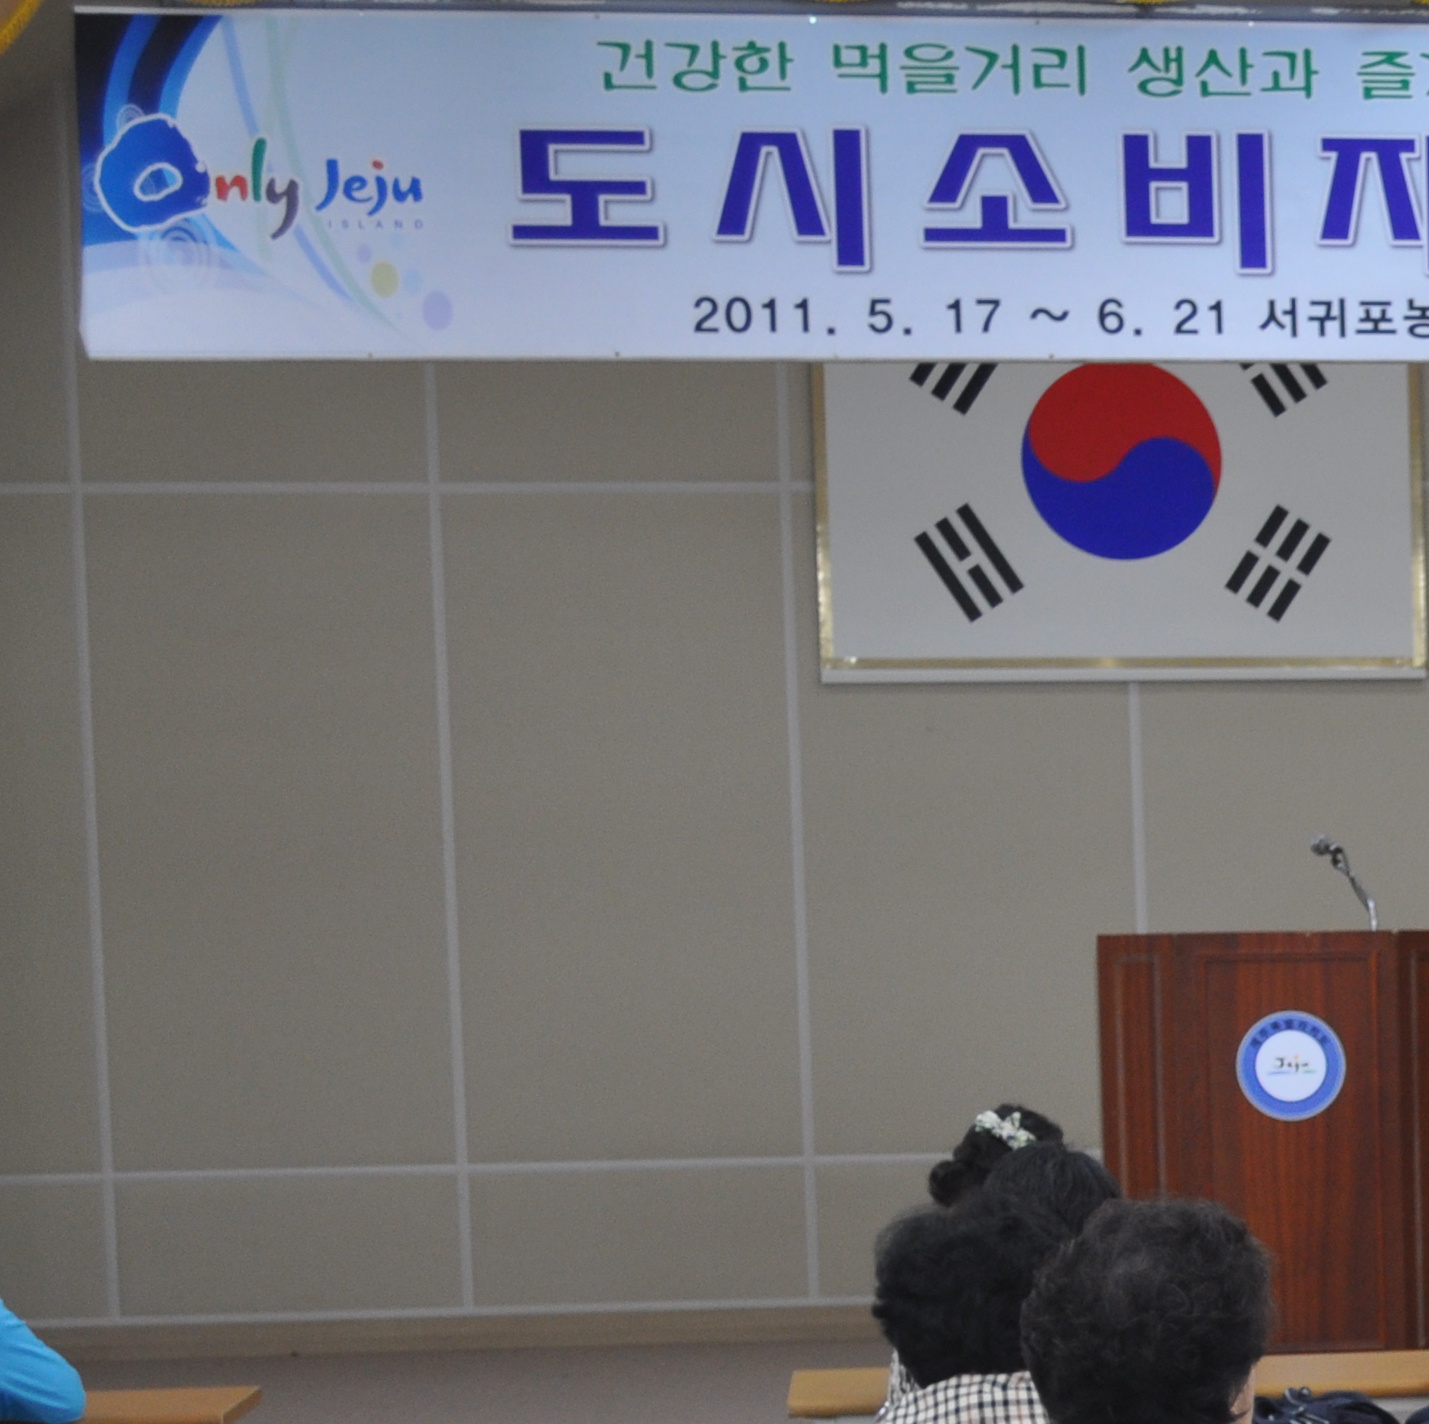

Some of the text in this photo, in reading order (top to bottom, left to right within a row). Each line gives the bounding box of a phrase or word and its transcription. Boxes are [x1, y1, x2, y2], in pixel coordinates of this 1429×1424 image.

[597, 40, 793, 93] 건강한
[831, 43, 1089, 95] 먹을거리
[1129, 47, 1319, 99] 생산과
[95, 113, 423, 240] Only Jeju
[327, 219, 424, 230] ISLAND
[693, 295, 837, 336] 2011.
[868, 297, 912, 336] 5.
[946, 297, 1001, 335] 17
[1097, 297, 1143, 337] 6.
[1174, 298, 1223, 335] 21
